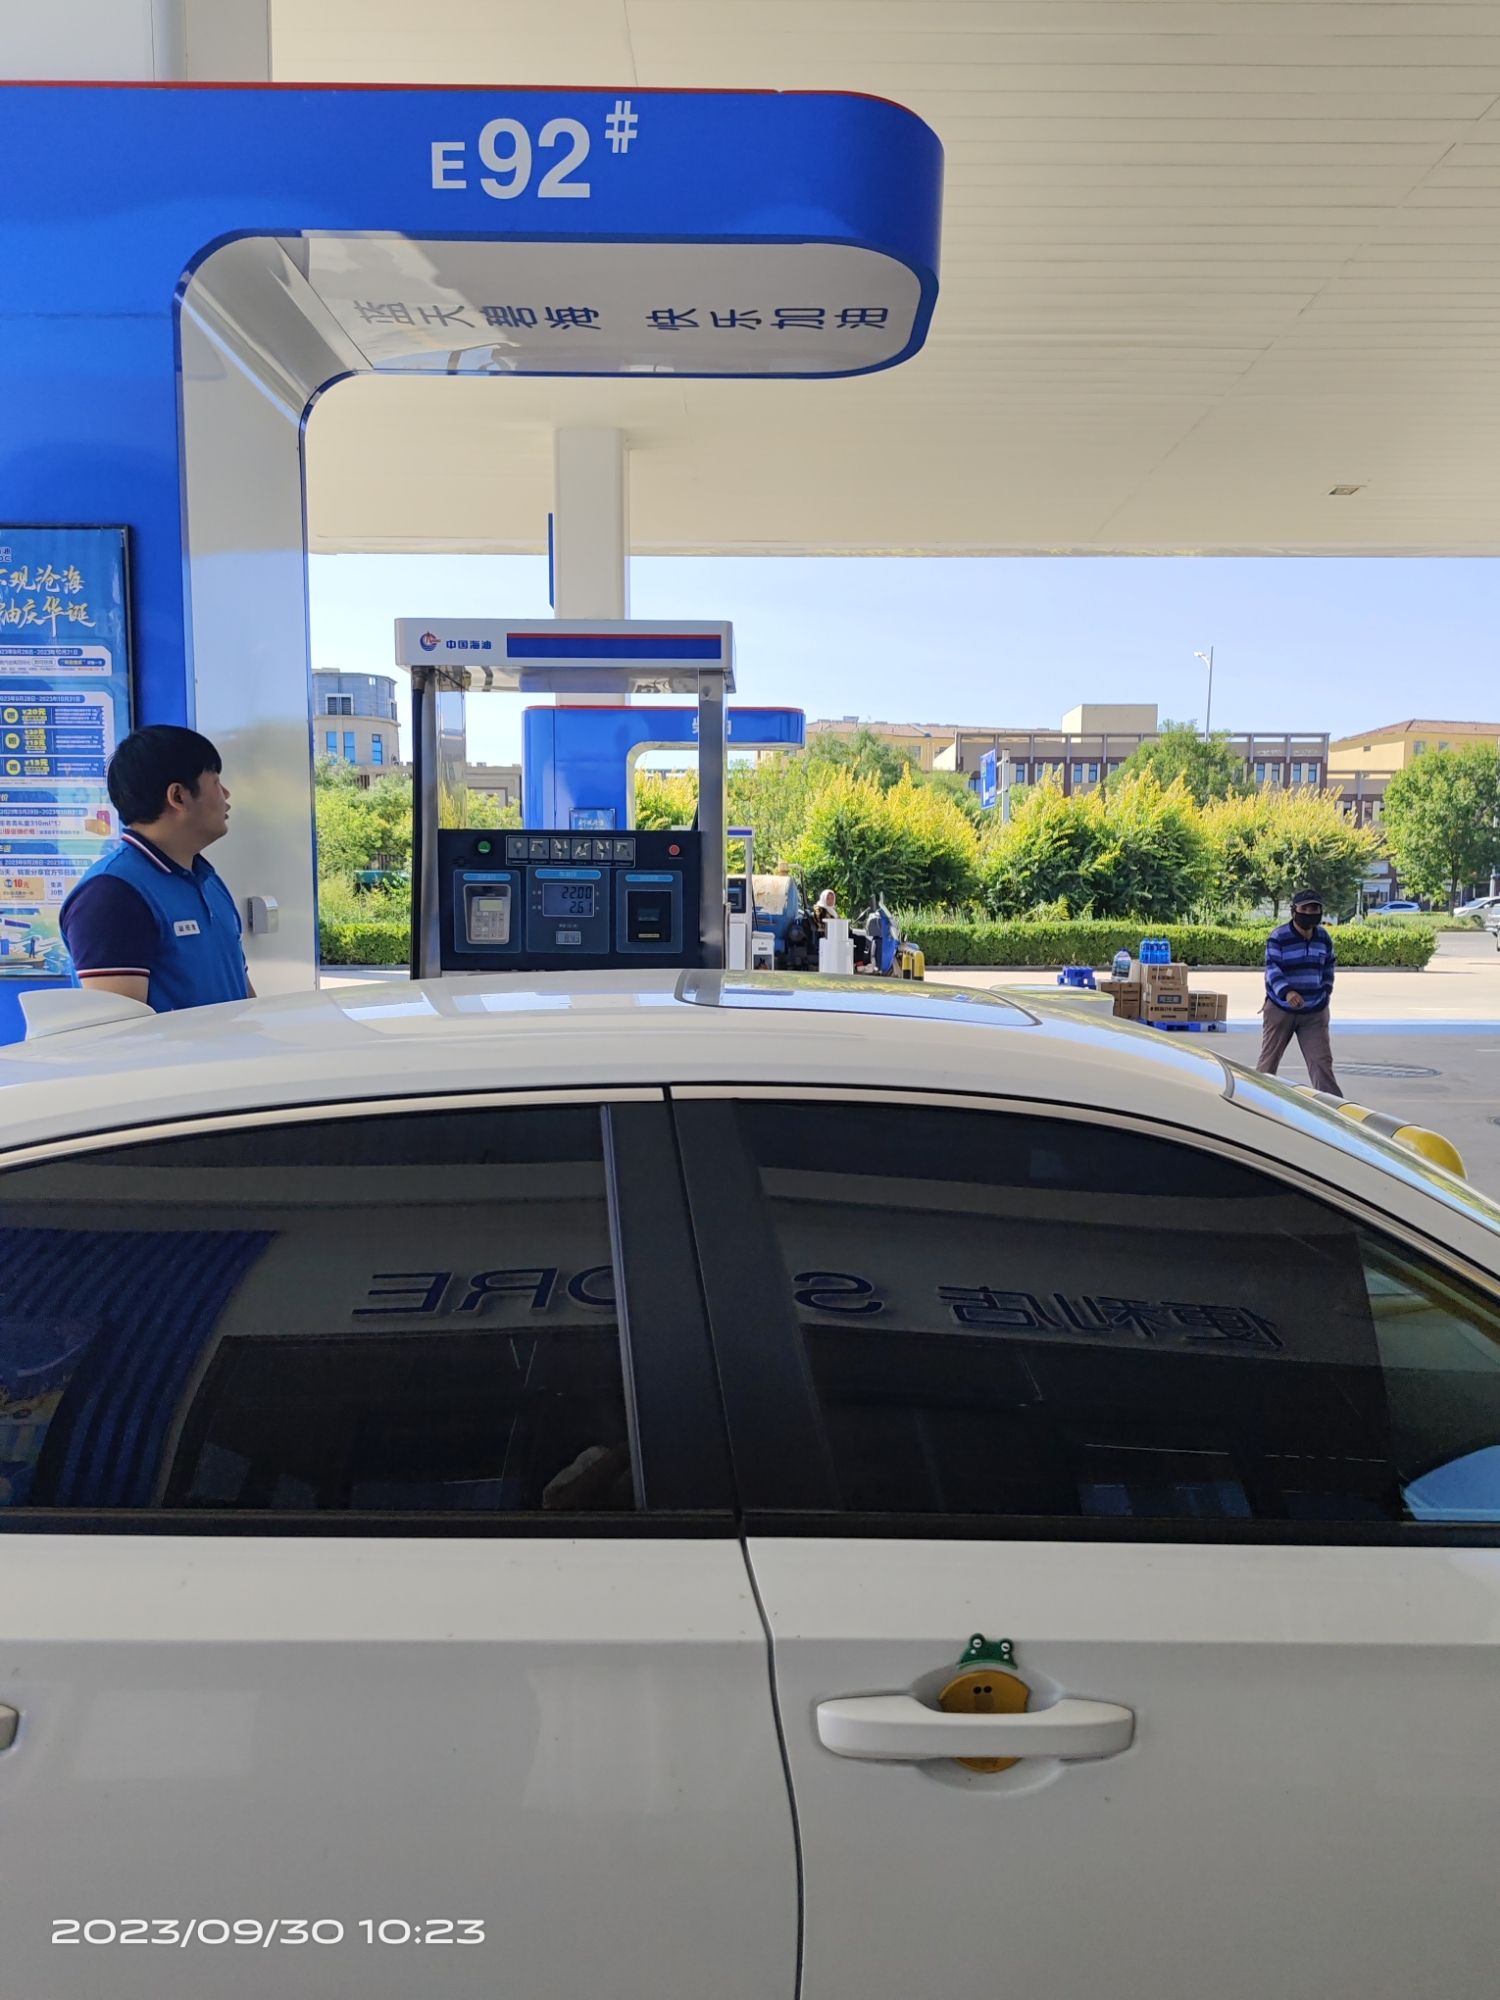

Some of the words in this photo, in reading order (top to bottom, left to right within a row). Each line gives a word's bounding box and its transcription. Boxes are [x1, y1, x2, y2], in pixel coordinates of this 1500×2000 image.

[353, 300, 601, 330] 蓝天碧海
[646, 307, 889, 330] 快乐加油
[446, 639, 492, 650] 中国海油
